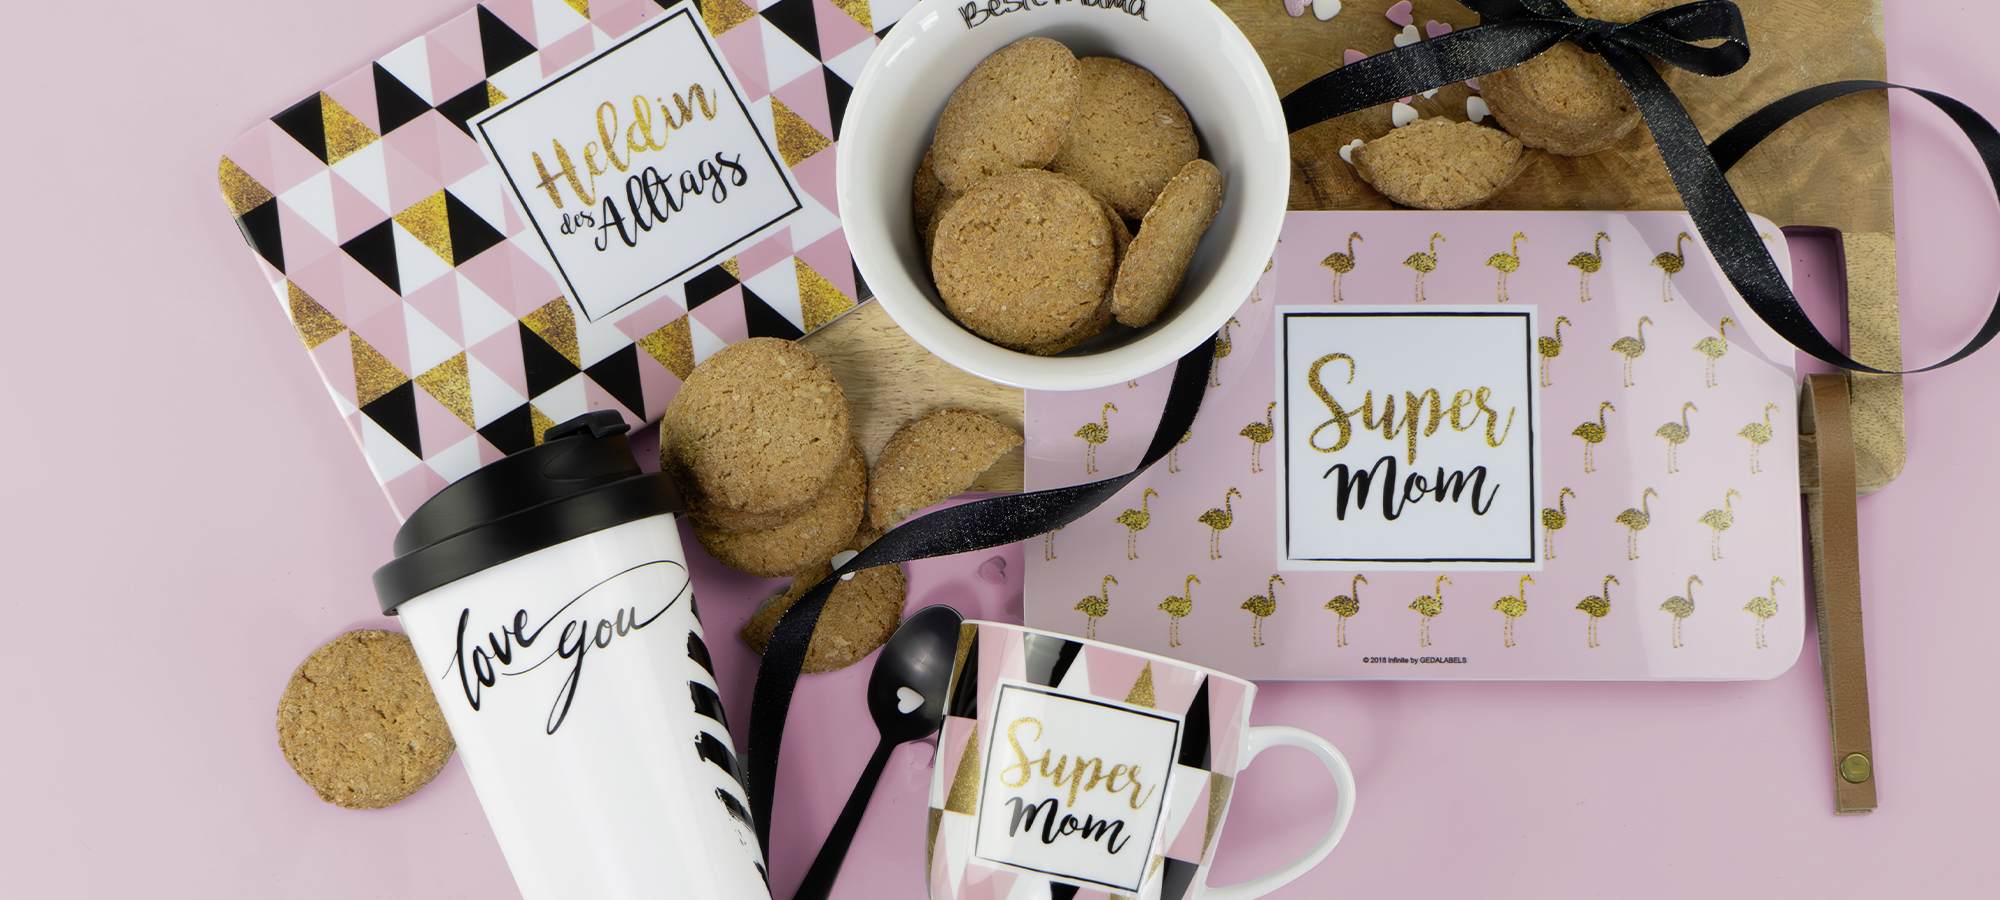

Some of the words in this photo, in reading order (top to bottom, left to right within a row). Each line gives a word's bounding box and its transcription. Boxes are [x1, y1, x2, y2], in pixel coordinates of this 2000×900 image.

[1054, 0, 1149, 21] ama
[531, 83, 717, 209] Heldin
[560, 209, 595, 235] des
[595, 151, 748, 252] Alltags
[1308, 352, 1516, 466] Super
[1322, 455, 1500, 521] Mom
[441, 607, 540, 712] love
[525, 603, 660, 735] you
[1410, 656, 1418, 665] by
[1419, 656, 1467, 664] GEDALABELS
[1000, 716, 1156, 811] Super
[1004, 796, 1131, 855] Mom
